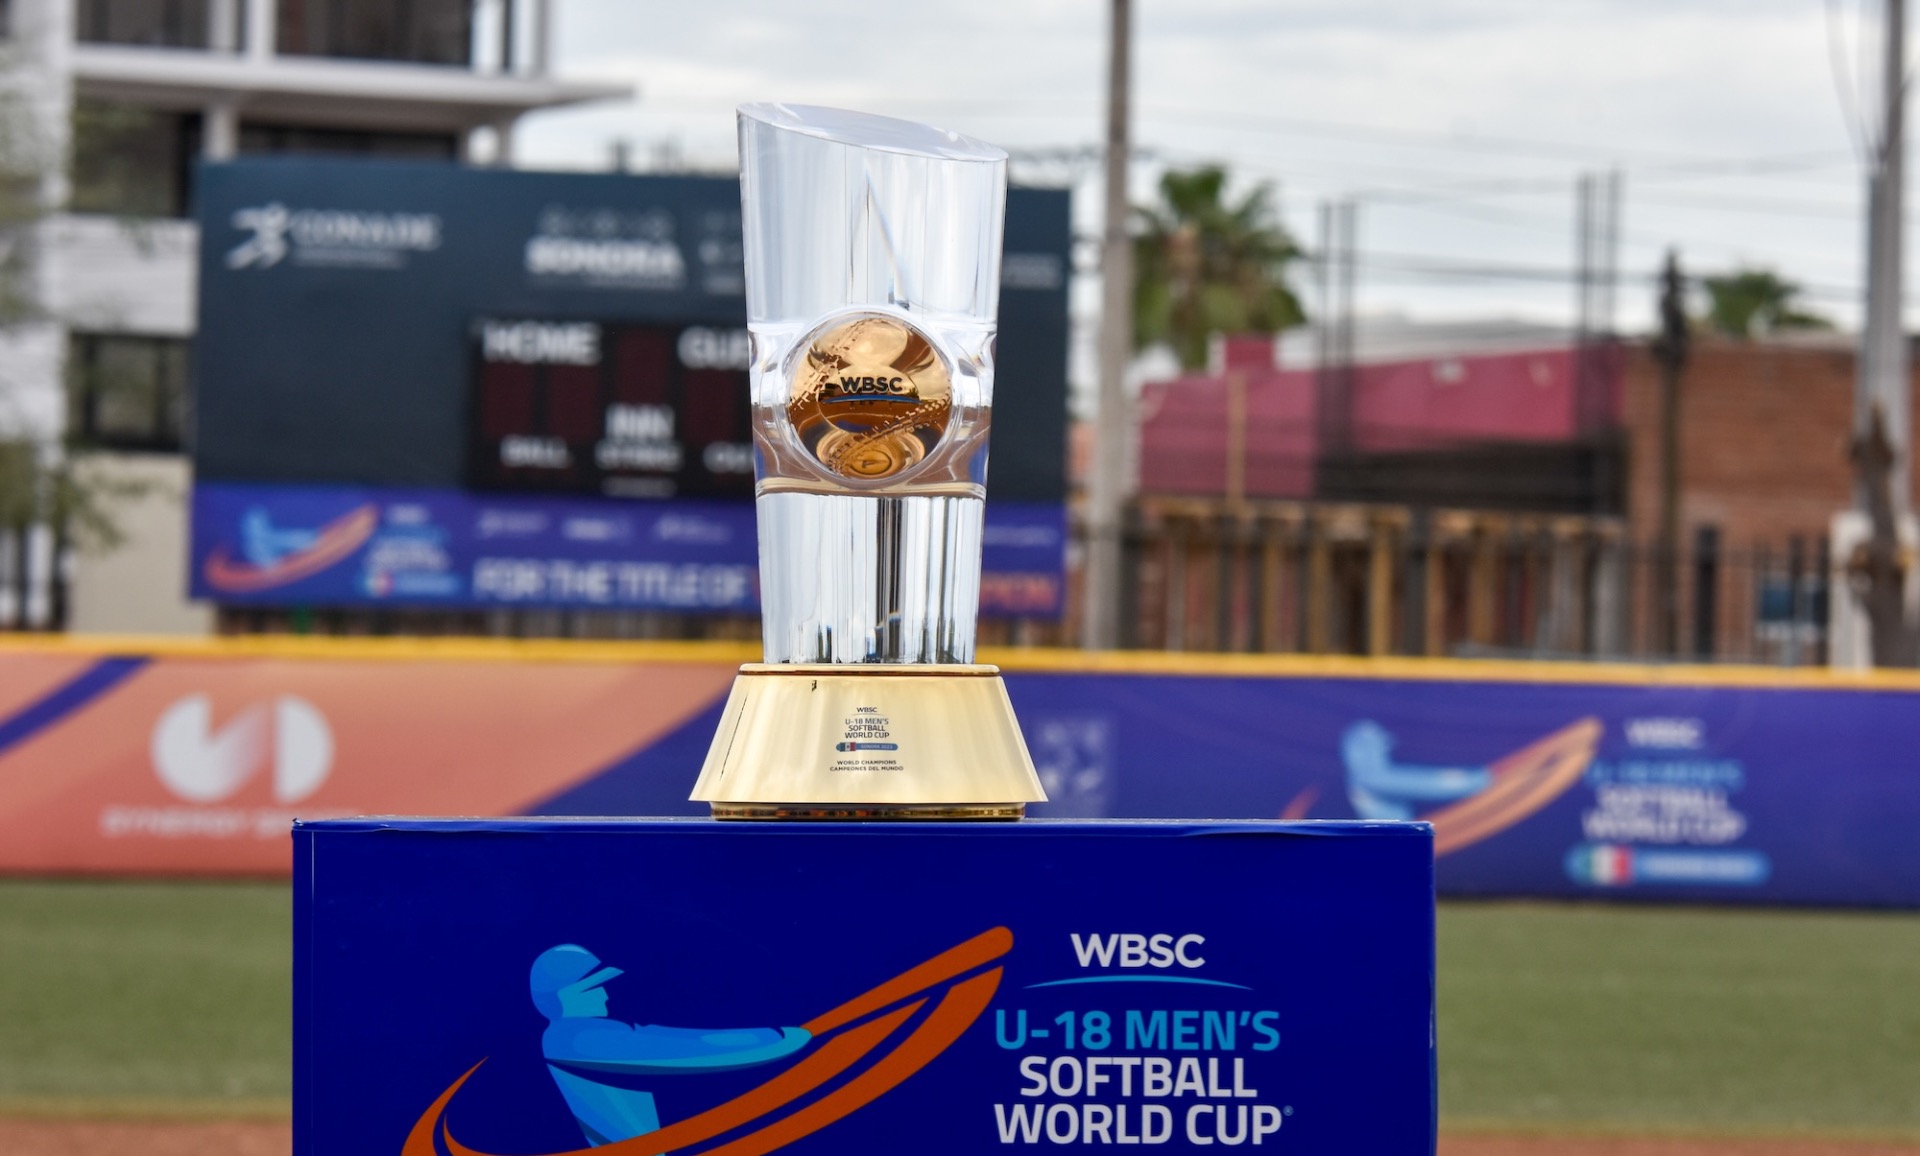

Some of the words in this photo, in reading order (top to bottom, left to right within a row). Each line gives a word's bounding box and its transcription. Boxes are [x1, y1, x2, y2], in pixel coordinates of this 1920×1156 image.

[293, 213, 441, 250] CONADE
[526, 238, 684, 275] SONORA
[485, 324, 600, 363] HOME
[679, 328, 748, 367] GUE
[840, 376, 903, 393] WBSC
[477, 562, 545, 597] FOR
[547, 563, 613, 600] THE
[614, 565, 703, 602] TITLE
[705, 568, 746, 603] OF
[1070, 933, 1206, 969] WBSC
[995, 1009, 1112, 1050] U-18
[1125, 1010, 1281, 1052] MEN'S
[1019, 1056, 1258, 1097] SOFTBALL
[994, 1103, 1173, 1144] WORLD
[1186, 1104, 1282, 1145] CUP
